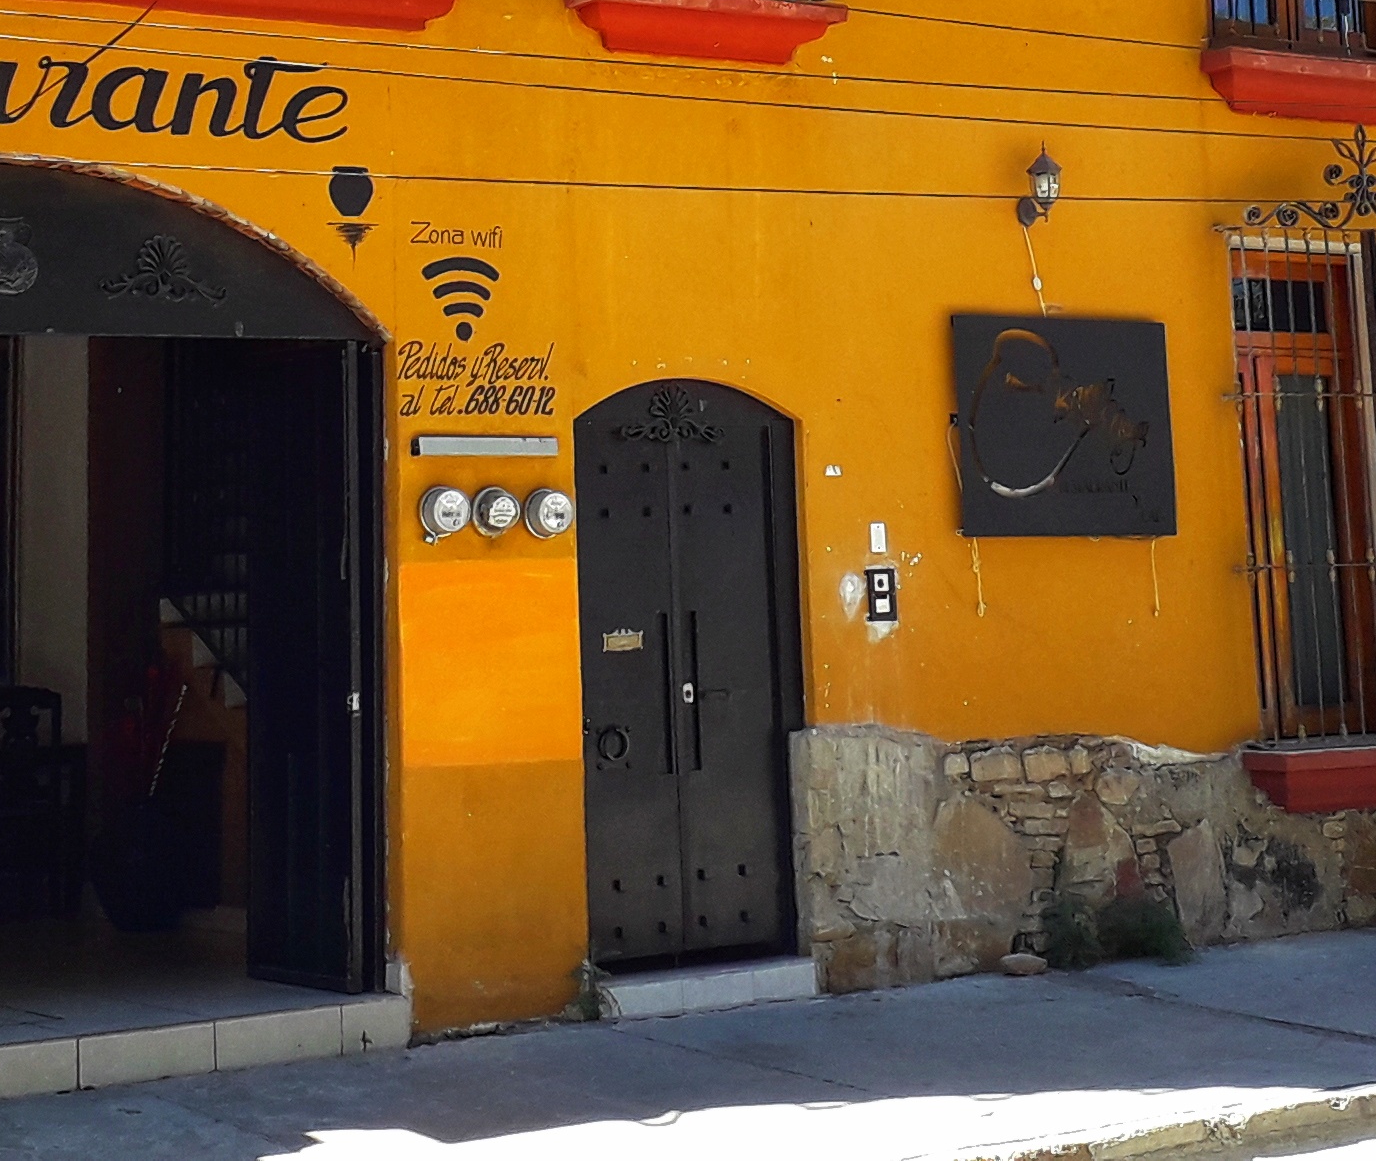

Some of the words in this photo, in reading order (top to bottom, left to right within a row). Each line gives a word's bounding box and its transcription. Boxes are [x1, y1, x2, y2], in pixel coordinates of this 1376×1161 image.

[410, 221, 465, 245] Zona
[471, 225, 503, 249] wifi
[397, 340, 467, 381] Pedidos
[399, 384, 426, 417] al
